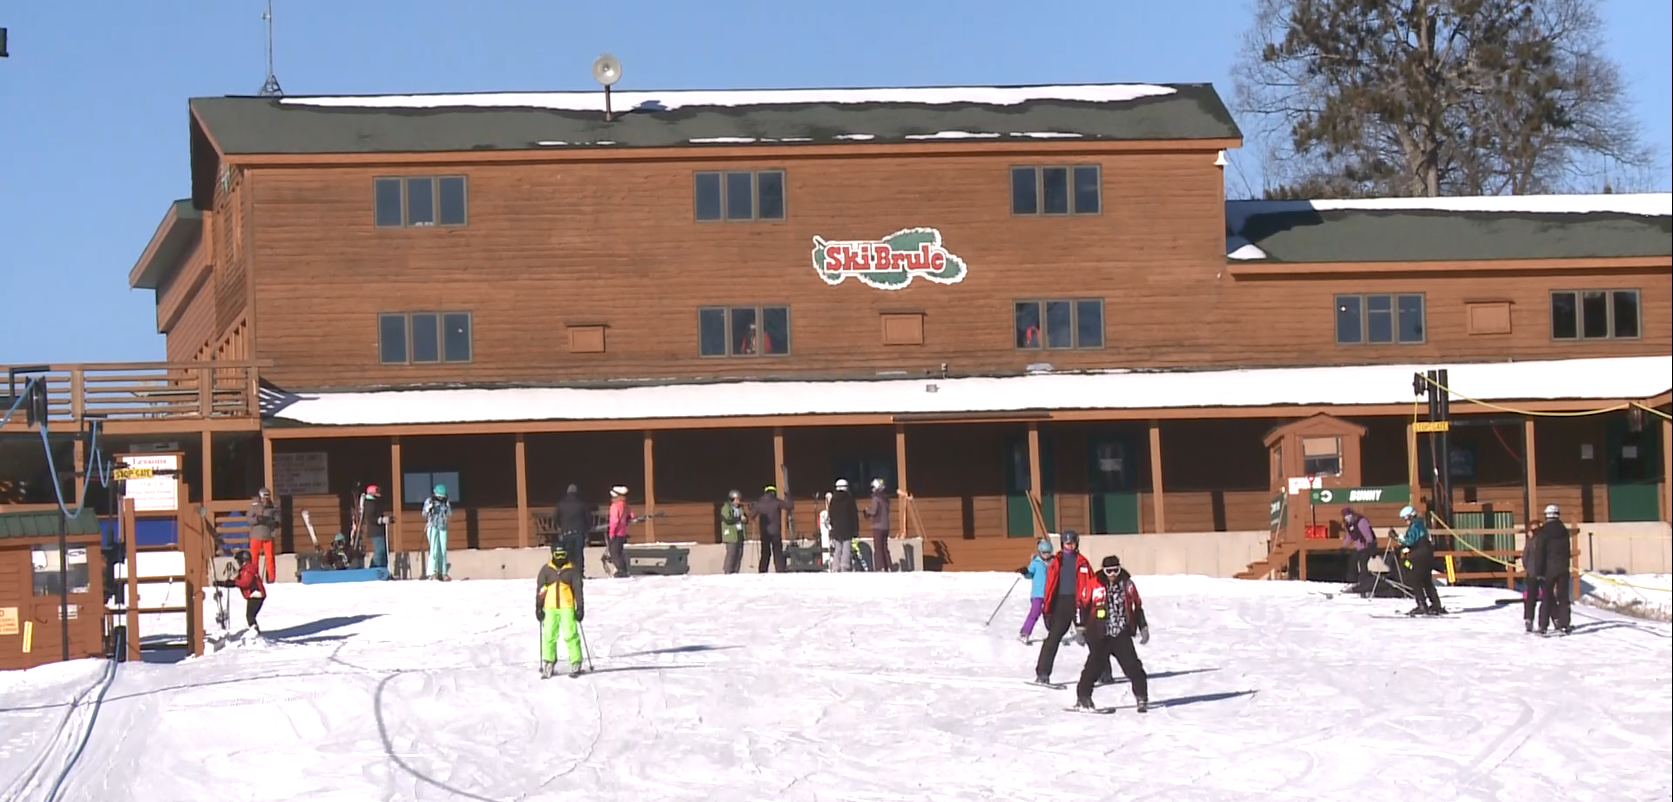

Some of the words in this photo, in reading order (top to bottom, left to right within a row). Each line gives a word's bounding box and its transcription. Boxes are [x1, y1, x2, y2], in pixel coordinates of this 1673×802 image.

[825, 245, 871, 271] Ski
[874, 244, 945, 271] Brule
[131, 457, 167, 465] Lessons
[115, 469, 134, 479] STOP
[135, 468, 152, 478] GATE
[1349, 489, 1382, 502] BUNNY
